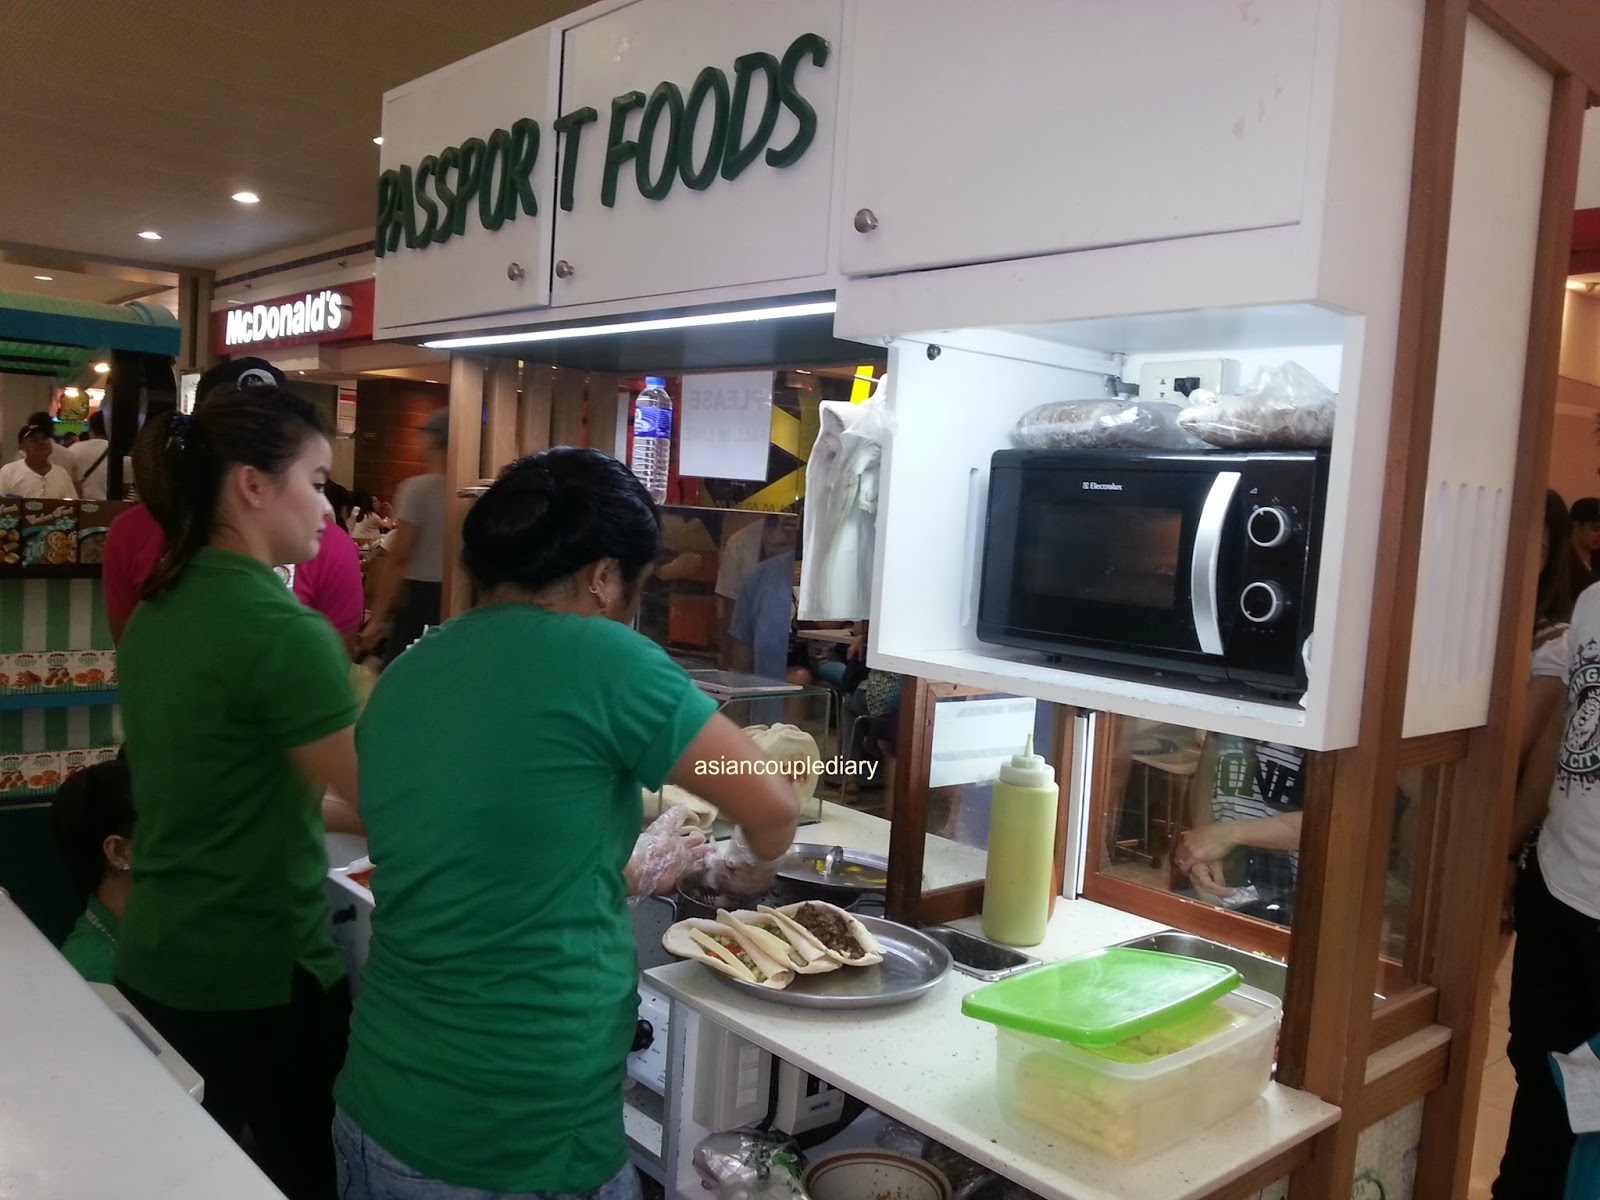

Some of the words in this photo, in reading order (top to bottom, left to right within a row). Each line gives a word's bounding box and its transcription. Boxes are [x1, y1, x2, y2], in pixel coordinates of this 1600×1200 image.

[601, 32, 830, 208] FOODS
[225, 289, 345, 346] McDonald's
[1089, 481, 1123, 491] Electrolux
